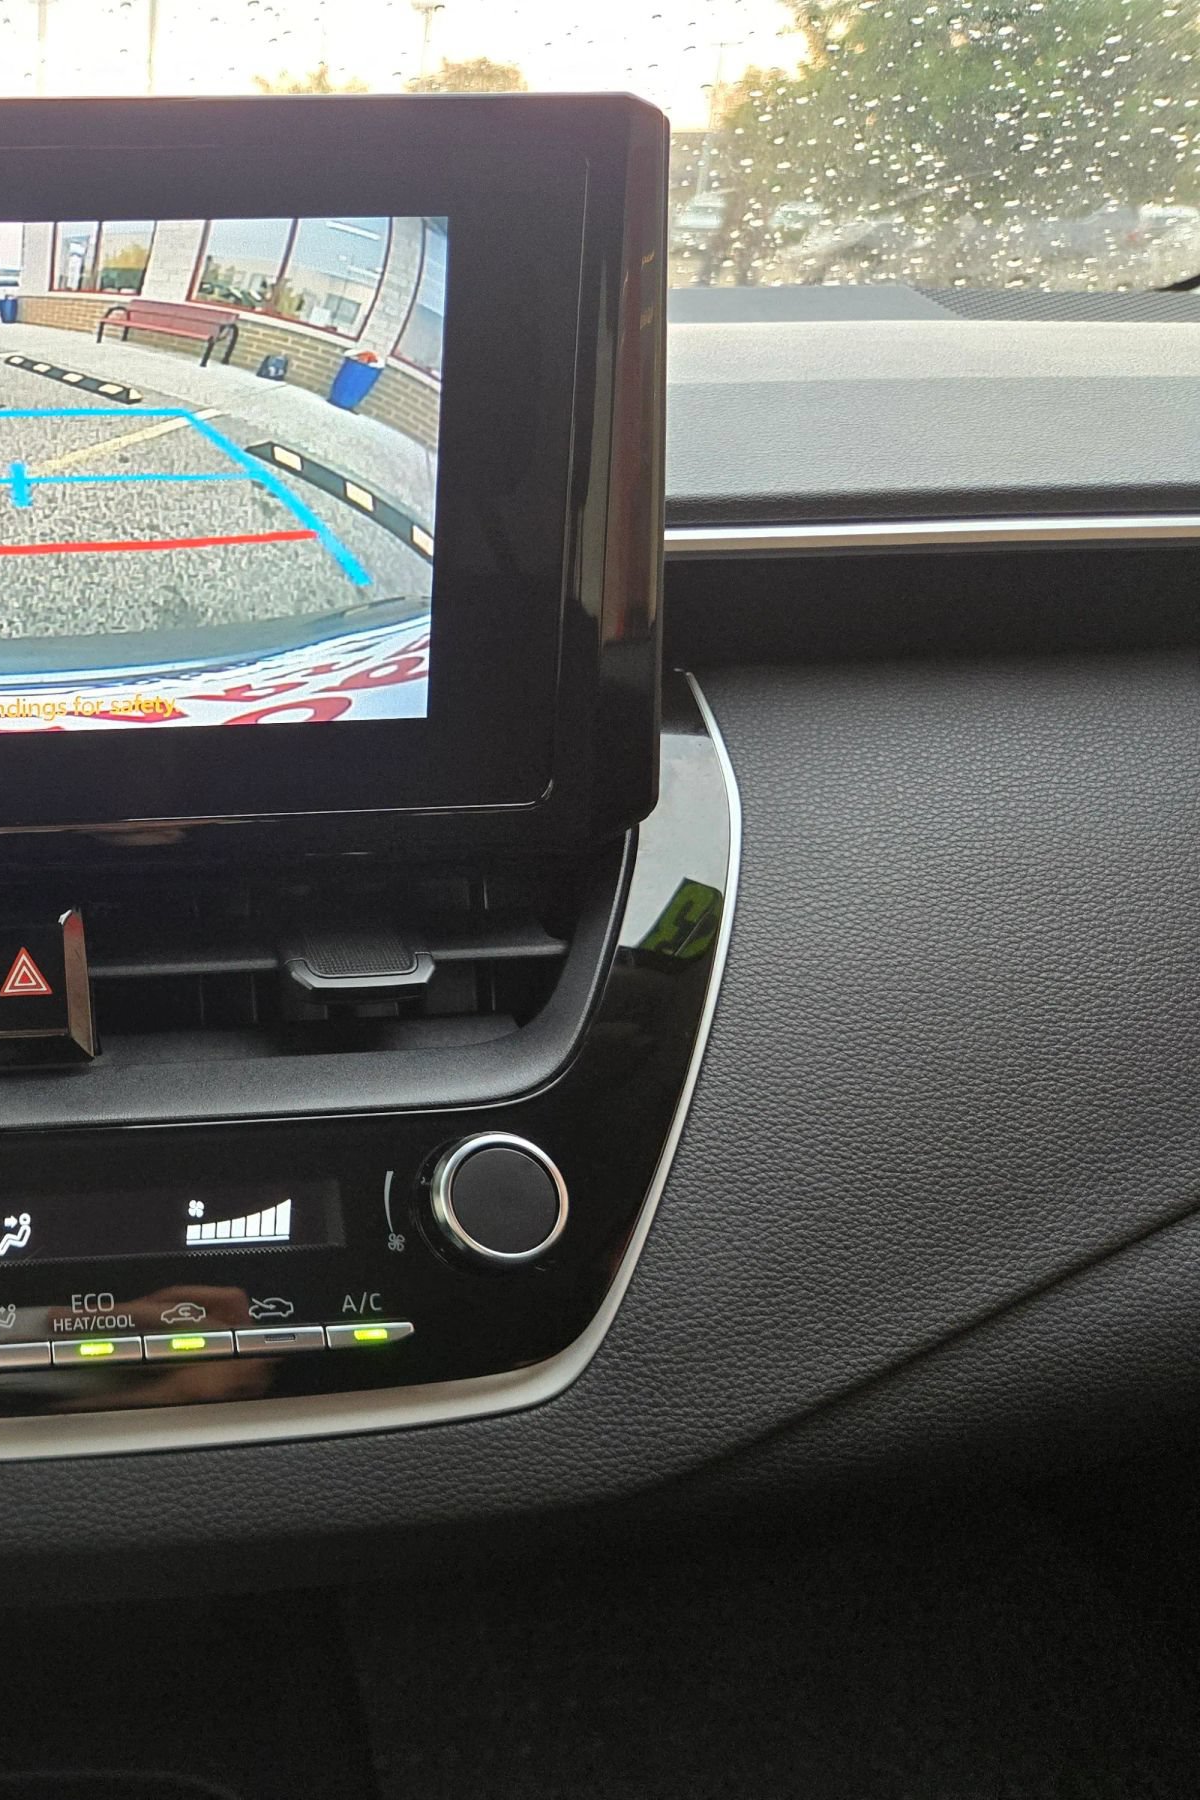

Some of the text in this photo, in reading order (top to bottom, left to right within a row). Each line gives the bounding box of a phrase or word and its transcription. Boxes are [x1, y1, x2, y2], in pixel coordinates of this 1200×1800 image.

[73, 696, 103, 715] for
[70, 1293, 115, 1313] ECO
[341, 1292, 383, 1314] A/C
[53, 1314, 136, 1333] HEAT/COOL
